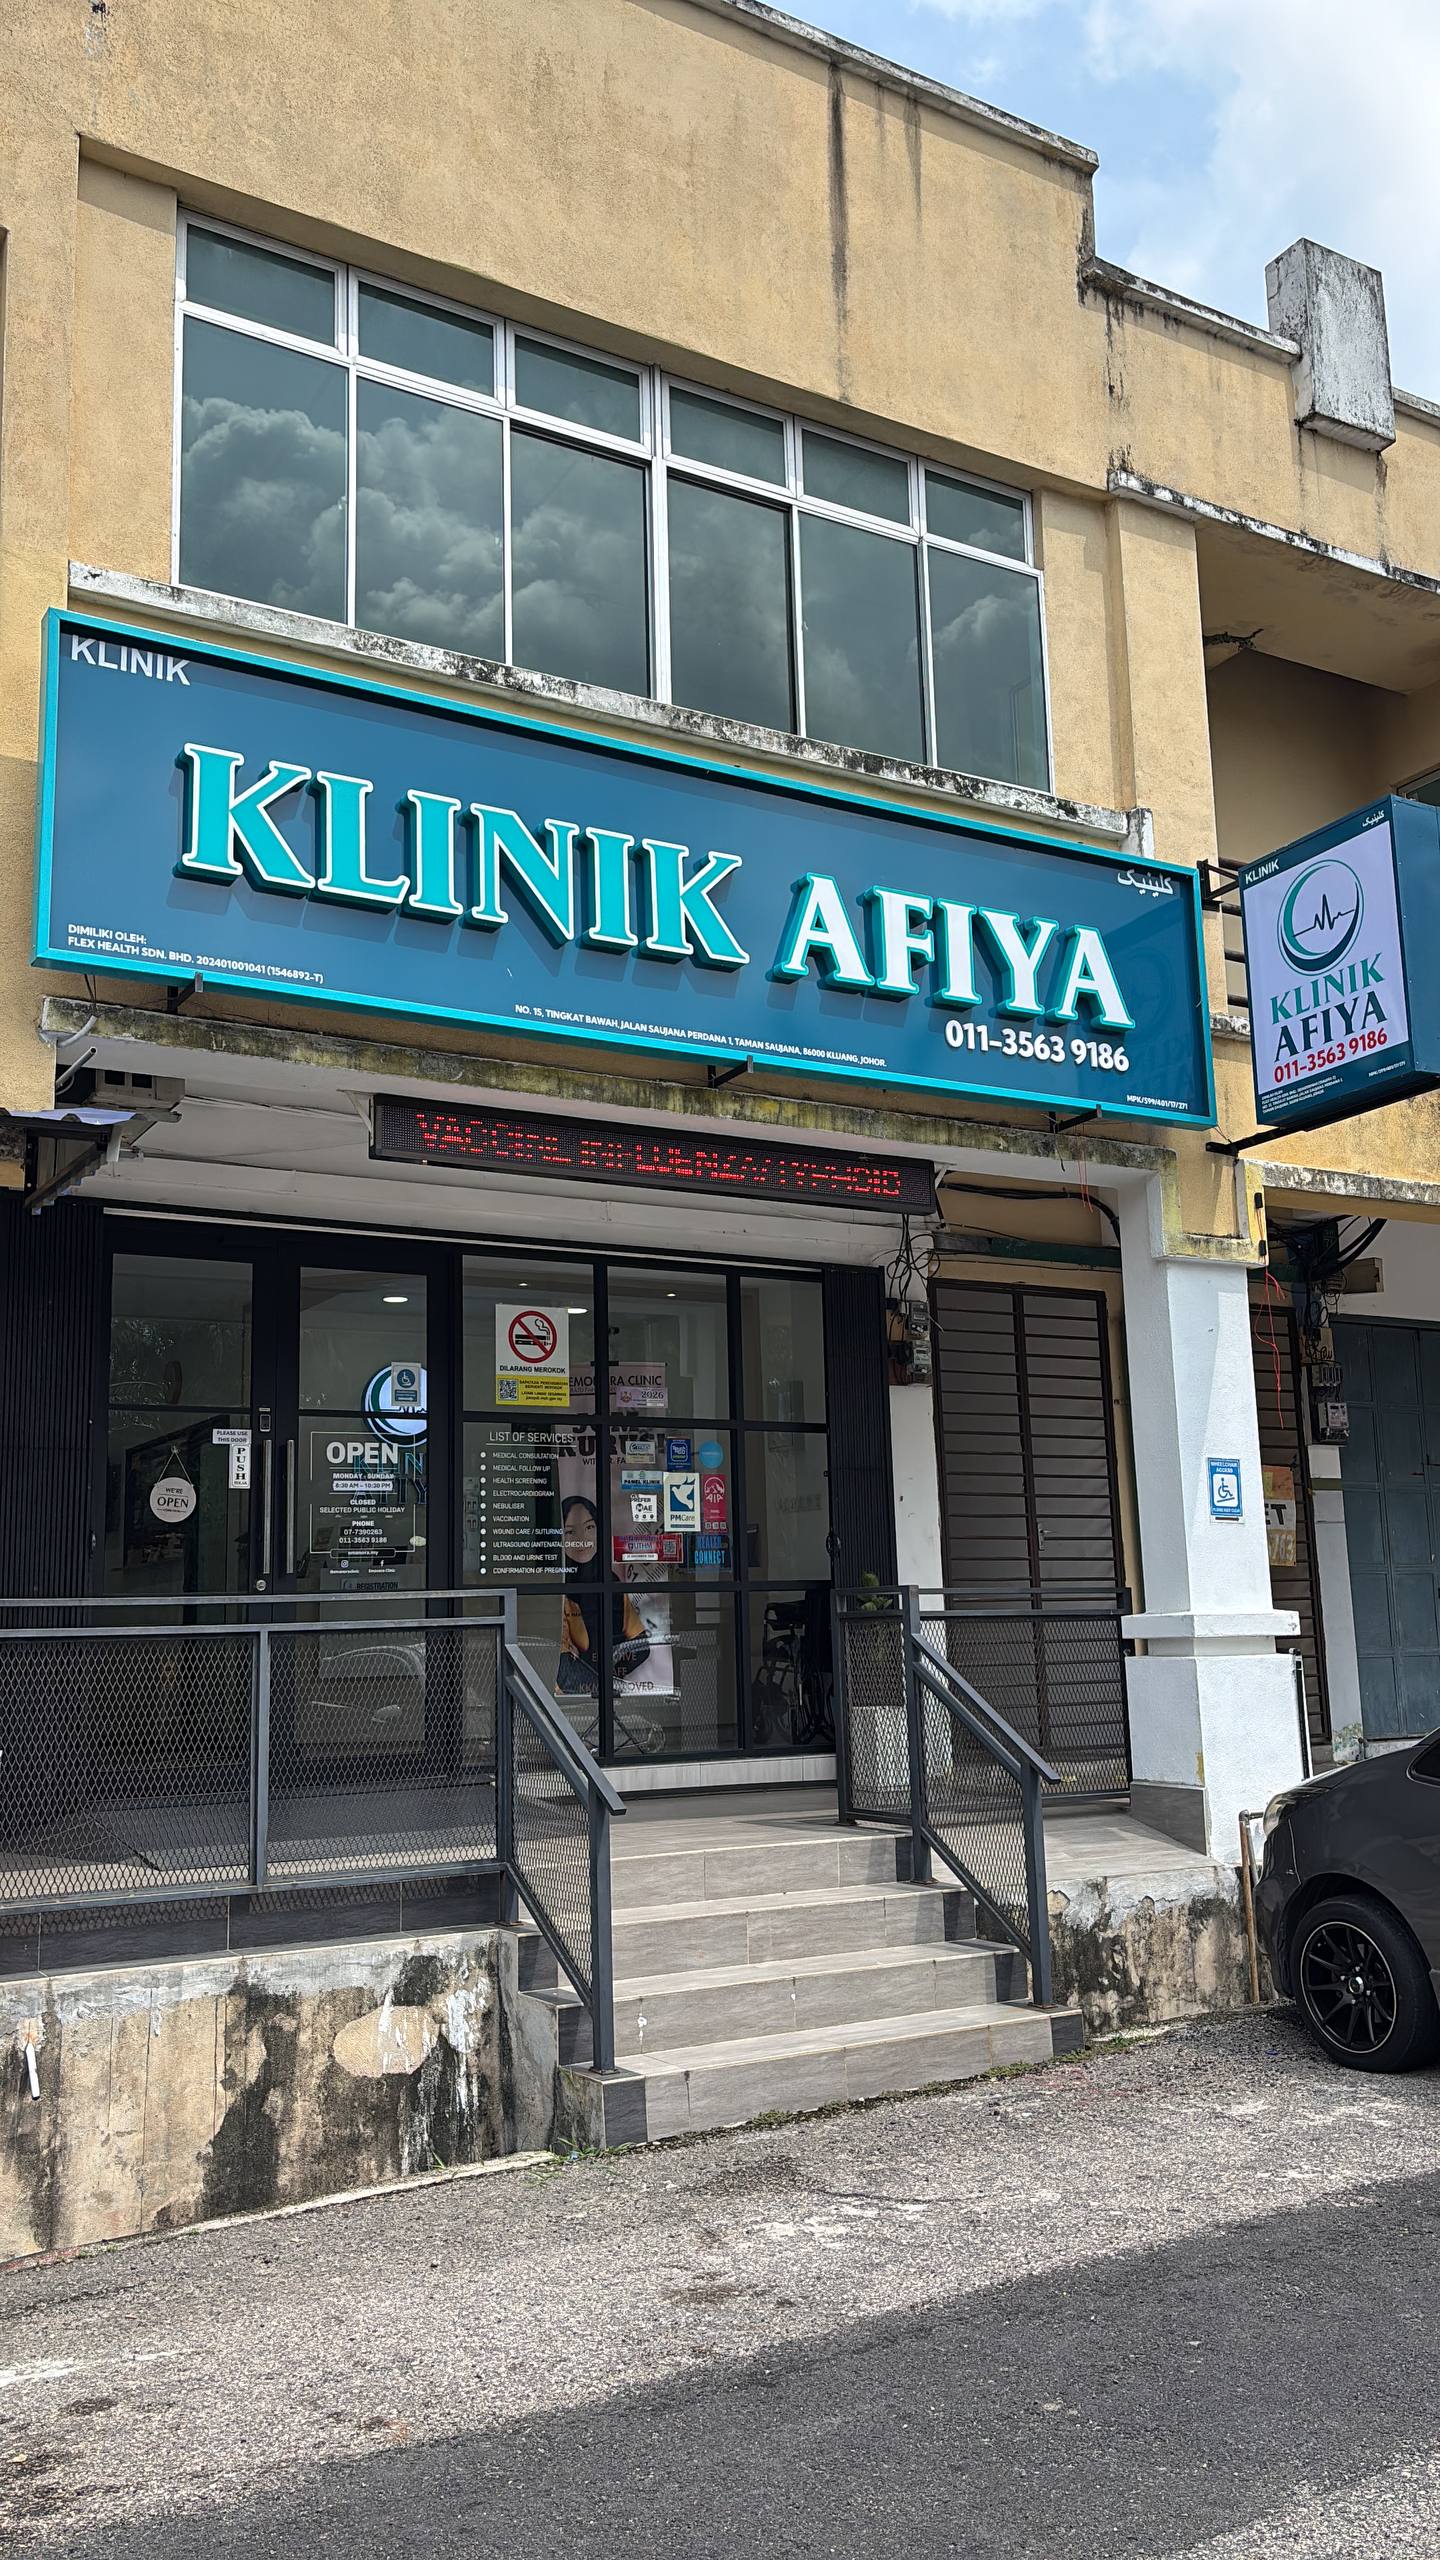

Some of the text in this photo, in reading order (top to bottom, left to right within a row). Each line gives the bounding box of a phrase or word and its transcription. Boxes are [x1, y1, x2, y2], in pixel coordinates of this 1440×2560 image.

[71, 634, 190, 686] KLINIK
[180, 741, 750, 966] KLINIK
[1245, 859, 1280, 885] KLINIK
[68, 924, 147, 945] DIMILIKI OLEH:
[68, 936, 324, 984] FLEX HEALTH SDN. BHD. 202401001041 (1546892-T)
[780, 872, 1136, 1031] AFIYA
[1270, 951, 1384, 1025] KLINIK
[515, 1004, 531, 1015] NO.
[546, 1009, 584, 1023] TINGKAT
[585, 1015, 620, 1029] BAWAH,
[620, 1020, 647, 1032] JALAN
[648, 1024, 686, 1038] SAUJANA
[687, 1030, 727, 1044] PERDANA
[735, 1038, 764, 1050] TAMAN
[803, 1047, 826, 1058] 86000
[827, 1051, 859, 1064] KLUANG,
[860, 1056, 887, 1067] JOHOR.
[1273, 990, 1388, 1062] AFIYA
[945, 1019, 1130, 1072] 011-3563 9186
[1274, 1044, 1346, 1083] 011-3563
[1349, 1027, 1388, 1055] 9186
[500, 1365, 532, 1373] DILARANG
[628, 1375, 662, 1386] CLINIC
[641, 1391, 664, 1399] 2026
[489, 1431, 574, 1443] LIST OF SERVICES
[236, 1447, 246, 1480] PUSH
[326, 1441, 399, 1464] OPEN
[518, 1452, 558, 1460] CONSULTATION
[515, 1477, 547, 1485] SCREENING
[157, 1496, 189, 1508] OPEN
[670, 1514, 695, 1522] PMCare
[695, 1551, 725, 1564] CONNECT
